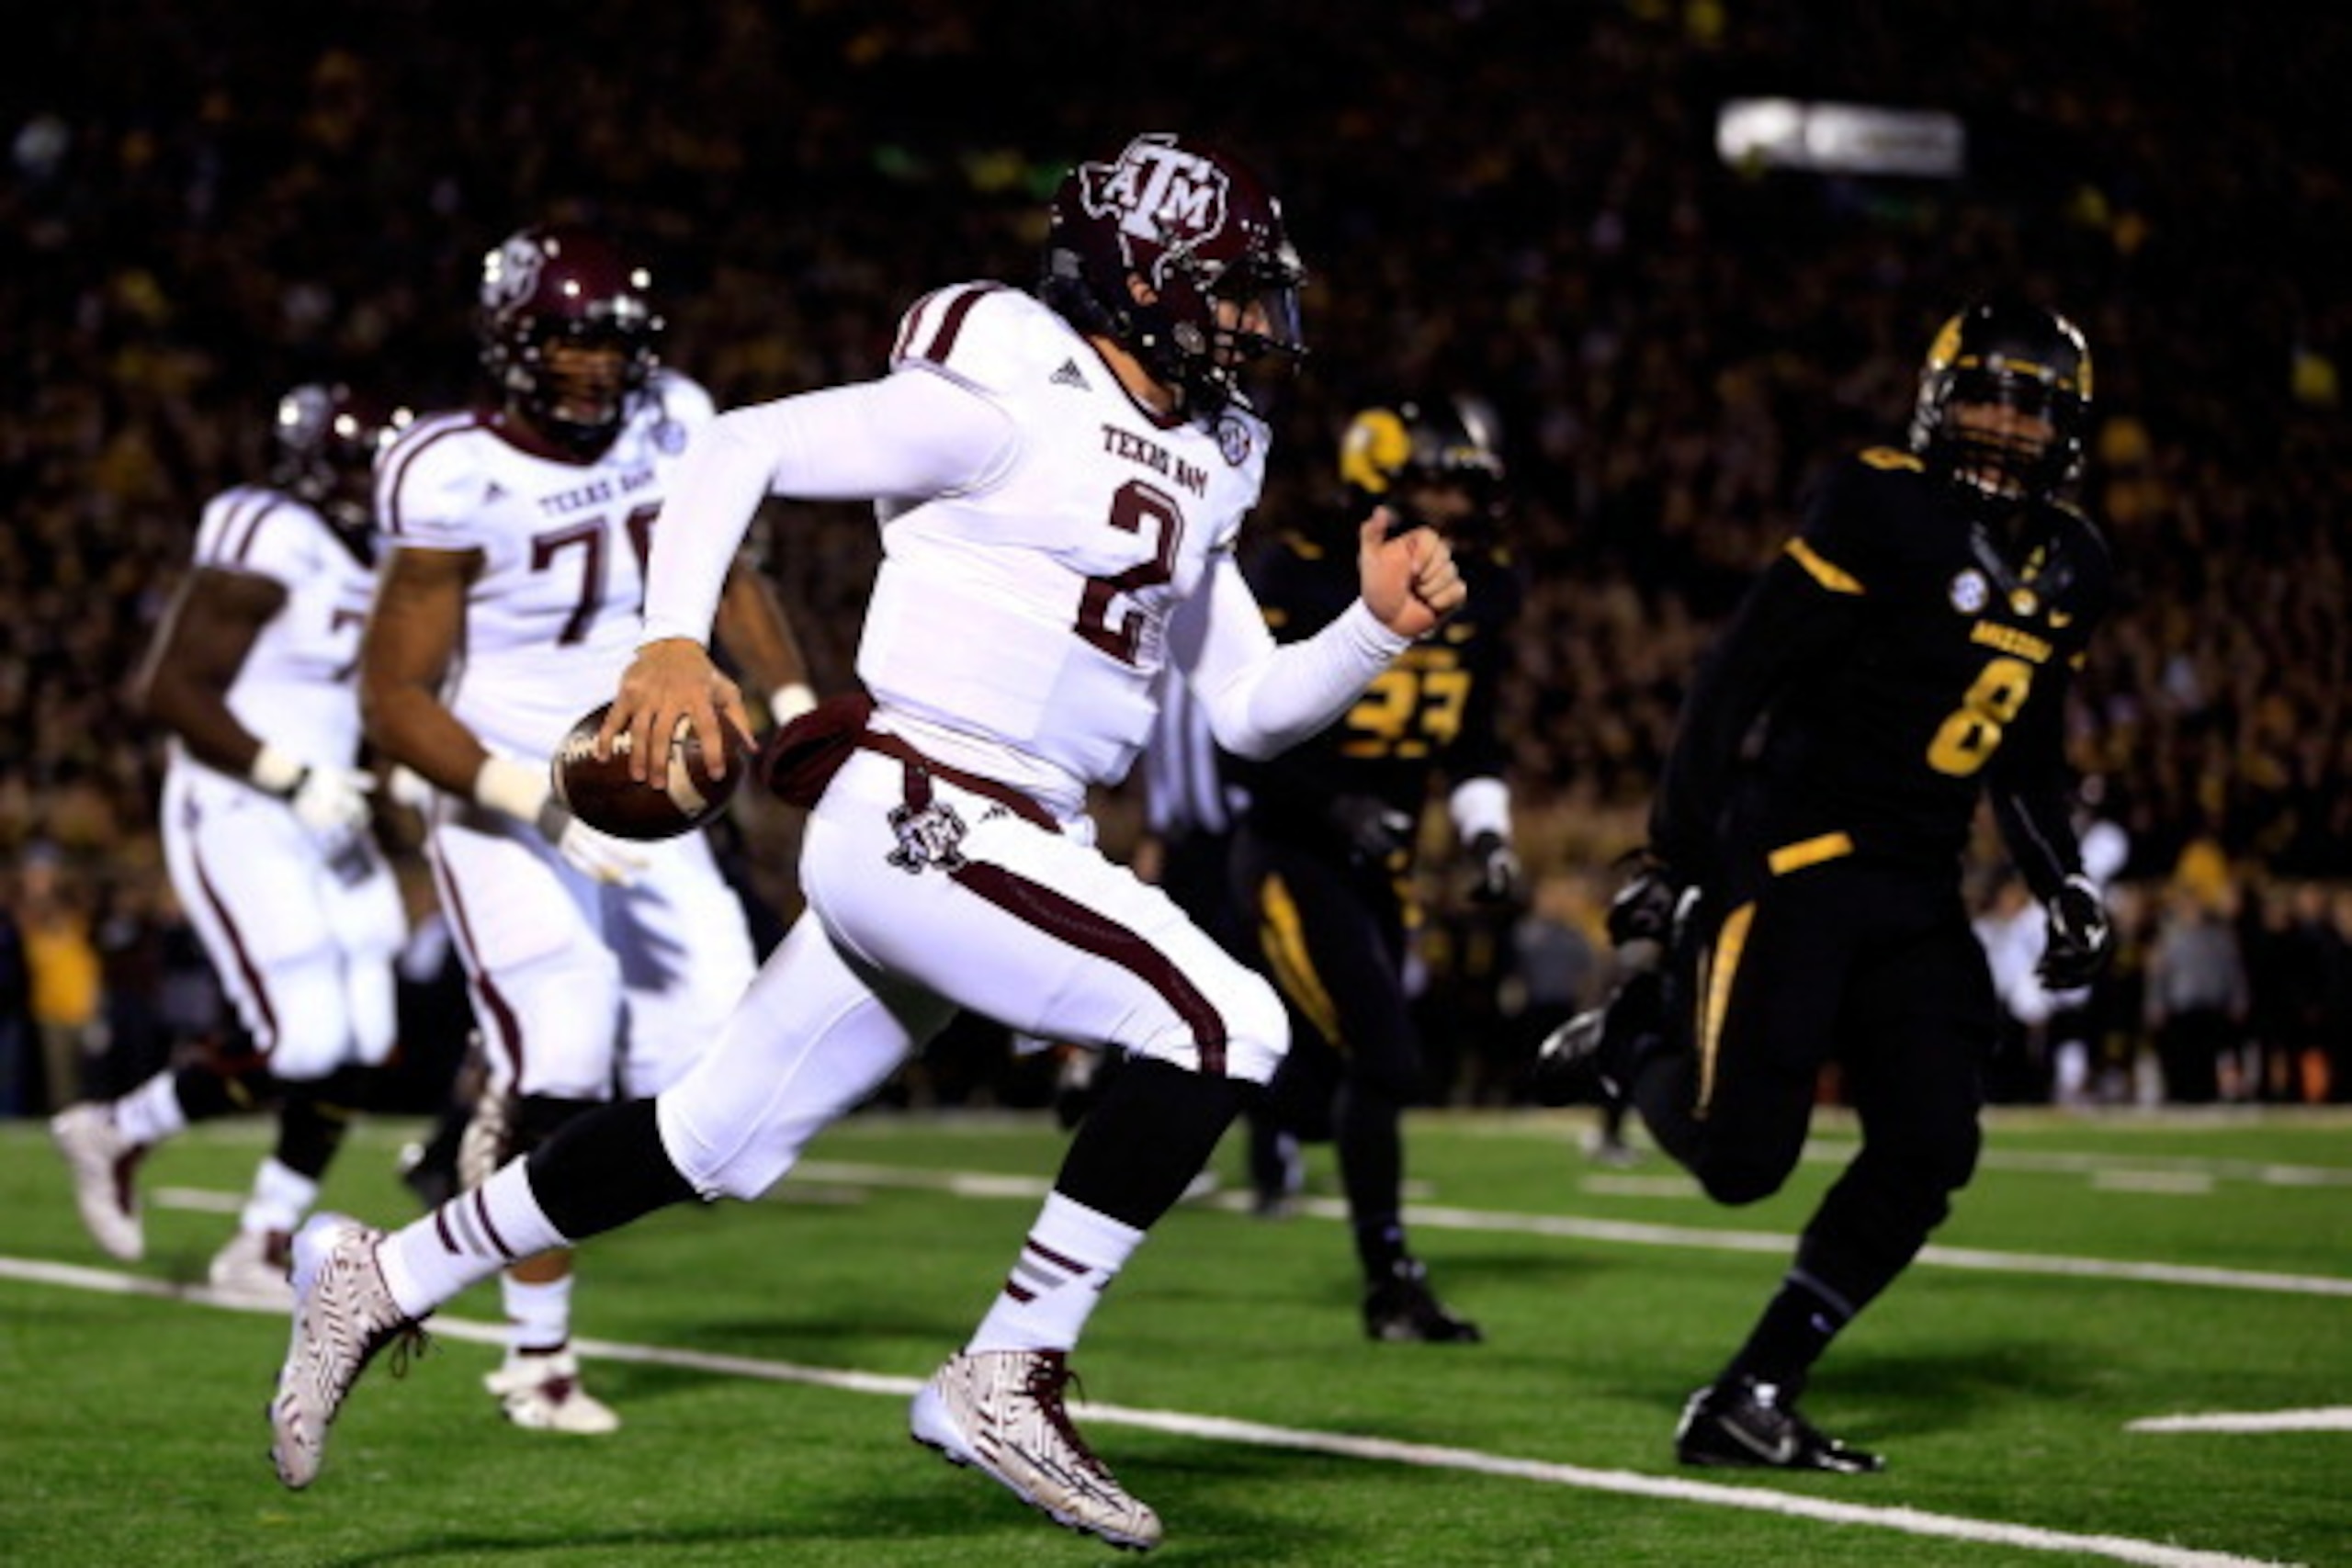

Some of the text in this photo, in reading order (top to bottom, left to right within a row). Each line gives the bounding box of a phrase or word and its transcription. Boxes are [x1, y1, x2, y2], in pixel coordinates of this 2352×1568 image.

[1101, 423, 1170, 477] TEXAS
[1071, 476, 1183, 668] 2
[1926, 656, 2034, 777] 8
